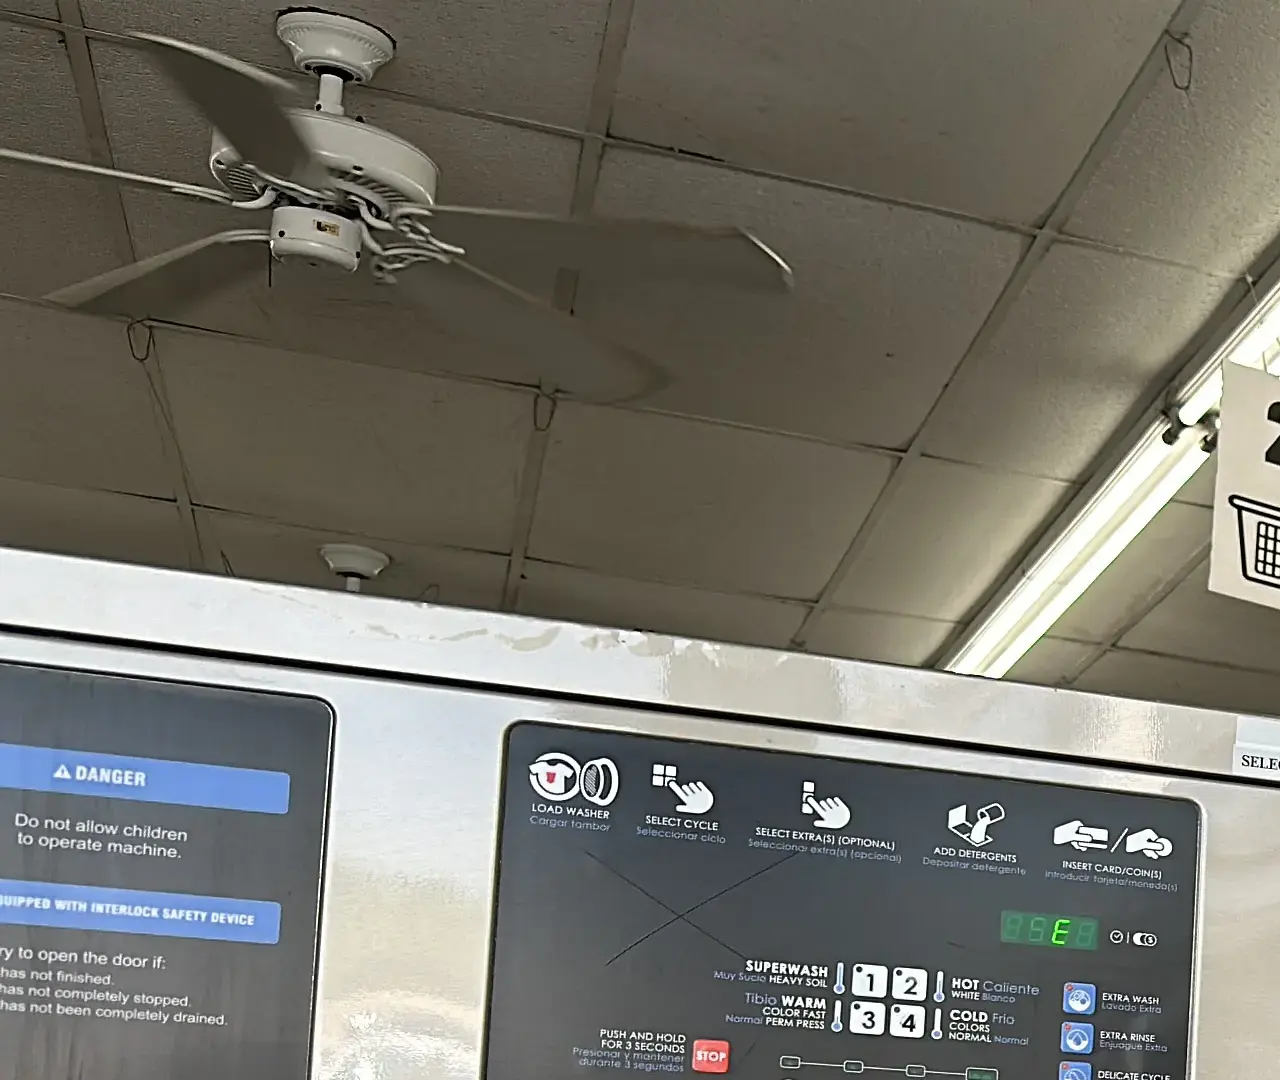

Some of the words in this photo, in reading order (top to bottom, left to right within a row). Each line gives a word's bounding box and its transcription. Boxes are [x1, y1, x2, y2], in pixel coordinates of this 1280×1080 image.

[76, 766, 145, 786] DANGER
[532, 804, 563, 814] LOAD
[566, 807, 610, 819] WASHER
[15, 813, 39, 828] Do
[45, 819, 70, 831] not
[76, 820, 119, 835] allow
[123, 825, 187, 842] children
[530, 816, 568, 828] Cargar
[572, 820, 610, 831] tambor
[646, 815, 682, 827] SELECT
[684, 820, 718, 831] CYCLE
[637, 826, 698, 840] Seleccionar
[701, 834, 726, 844] ciclo
[756, 827, 790, 838] SELECT
[792, 831, 835, 845] EXTRA(S)
[838, 836, 895, 851] (OPTIONAL)
[18, 832, 33, 845] to
[39, 836, 102, 851] operate
[108, 843, 181, 858] machine.
[749, 838, 808, 852] Seleccionar
[810, 847, 847, 858] extra(s)
[851, 850, 901, 864] (opcional)
[934, 847, 956, 856] ADD
[959, 849, 1016, 863] DETERGENTS
[923, 857, 970, 869] Depositar
[972, 864, 1026, 875] detergente
[1063, 861, 1092, 871] INSERT
[1095, 864, 1161, 880] CARD/COIN(S)
[55, 900, 87, 912] WITH
[91, 903, 159, 918] INTERLOCK
[163, 908, 207, 922] SAFETY
[211, 912, 254, 926] DEVICE
[1052, 920, 1070, 945] E
[19, 947, 33, 959] to
[38, 950, 78, 964] open
[84, 951, 108, 965] the
[112, 953, 148, 968] door
[153, 956, 165, 969] if:
[746, 960, 828, 977] SUPERWASH
[31, 970, 52, 981] not
[57, 971, 114, 985] finished.
[714, 971, 736, 981] Muy
[739, 972, 766, 983] Sucio
[769, 975, 803, 985] HEAVY
[806, 978, 827, 988] SOIL
[865, 974, 874, 991] 1
[904, 976, 917, 994] 2
[952, 978, 979, 990] HOT
[983, 981, 1039, 995] Caliente
[28, 987, 50, 997] not
[55, 989, 130, 1005] completely
[134, 994, 191, 1008] stopped.
[746, 993, 777, 1005] Tibio
[782, 995, 826, 1009] WARM
[952, 991, 979, 1000] WHITE
[982, 993, 1016, 1003] Blanco
[1103, 993, 1130, 1003] EXTRA
[1133, 996, 1159, 1005] WASH
[30, 1003, 52, 1014] not
[56, 1003, 91, 1016] been
[96, 1008, 170, 1024] completely
[173, 1012, 228, 1025] drained.
[762, 1007, 800, 1017] COLOR
[803, 1010, 825, 1019] FAST
[1102, 1002, 1136, 1012] Lavado
[1140, 1005, 1161, 1014] Extra
[726, 1014, 763, 1024] Normal
[766, 1017, 793, 1027] PERM
[797, 1019, 824, 1029] PRESS
[862, 1011, 875, 1030] 3
[902, 1014, 916, 1032] 4
[950, 1010, 988, 1022] COLD
[992, 1013, 1015, 1025] Frio
[949, 1022, 990, 1033] COLORS
[600, 1029, 626, 1039] PUSH
[629, 1032, 653, 1041] AND
[657, 1033, 686, 1043] HOLD
[949, 1032, 992, 1043] NORMAL
[994, 1036, 1029, 1045] Normal
[1100, 1031, 1128, 1041] EXTRA
[1131, 1033, 1155, 1043] RINSE
[602, 1040, 622, 1049] FOR
[626, 1041, 632, 1050] 3
[635, 1042, 685, 1054] SECONDS
[1100, 1040, 1143, 1051] Enjuague
[1145, 1043, 1168, 1052] Extra
[573, 1047, 620, 1058] Presionar
[624, 1052, 630, 1060] y
[633, 1053, 684, 1063] mantener
[696, 1051, 726, 1062] STOP
[579, 1057, 621, 1068] durante
[625, 1060, 630, 1069] 3
[634, 1063, 684, 1072] segundos
[1098, 1071, 1139, 1080] DELICATE
